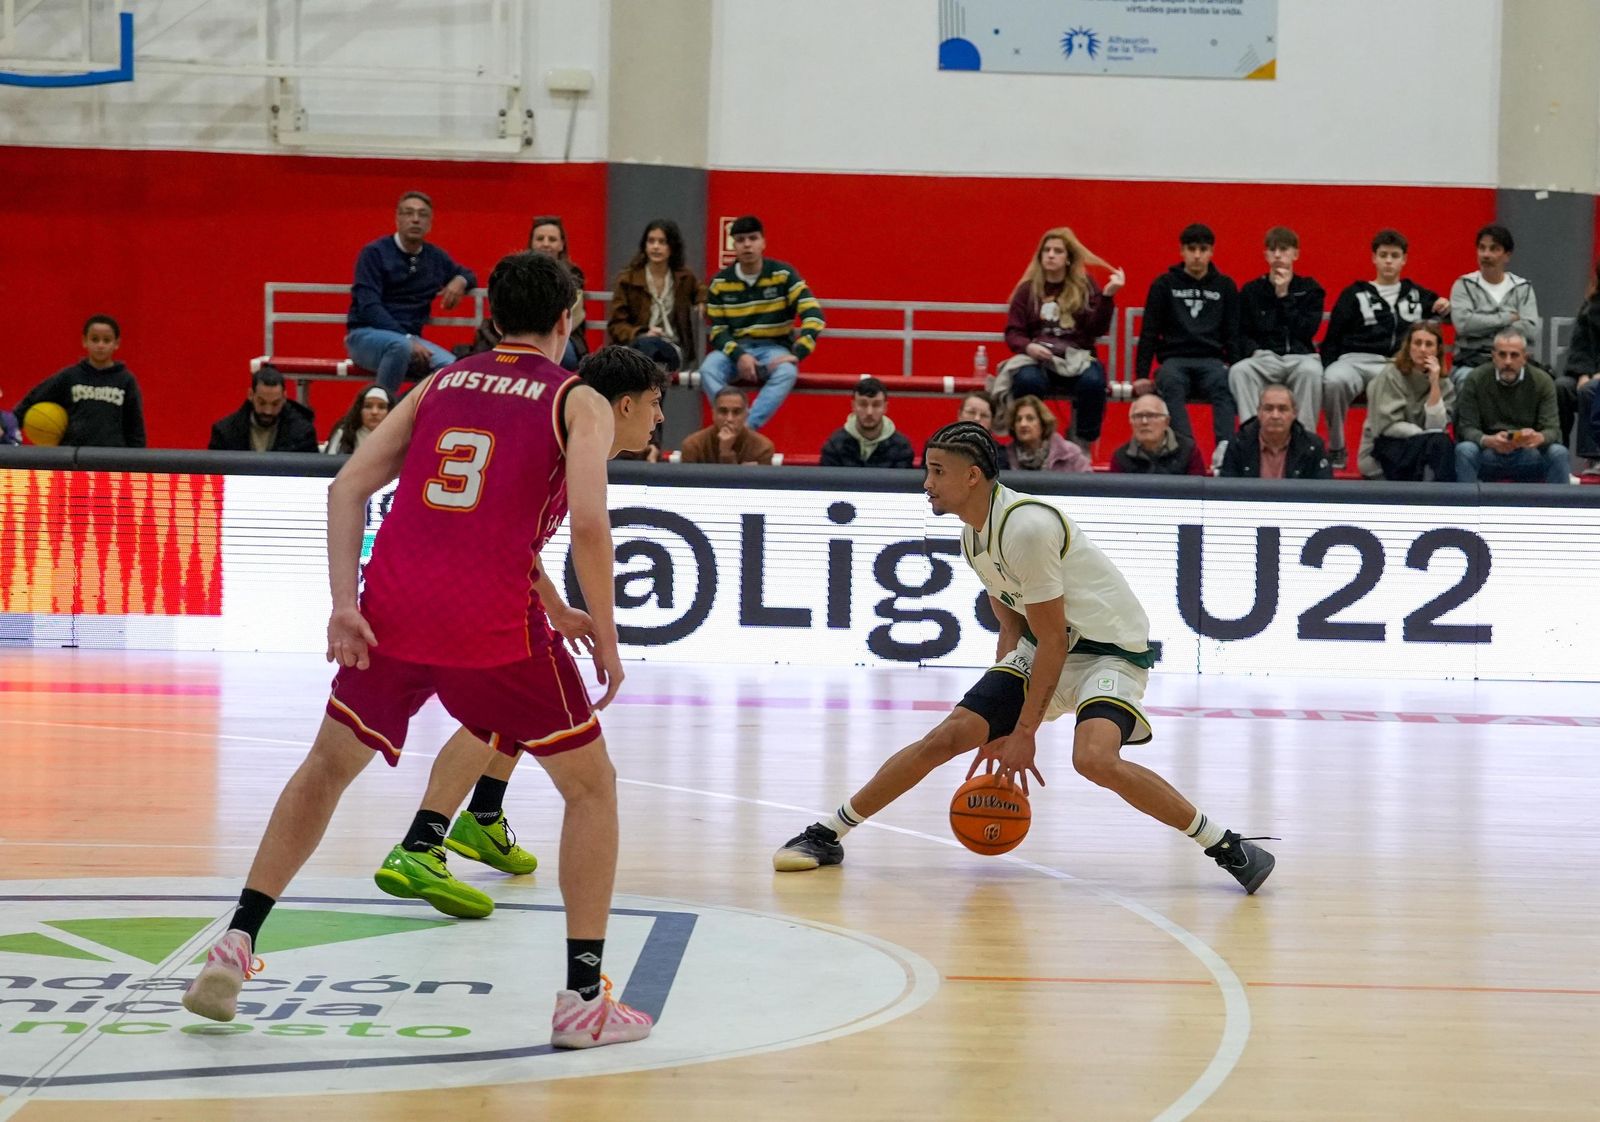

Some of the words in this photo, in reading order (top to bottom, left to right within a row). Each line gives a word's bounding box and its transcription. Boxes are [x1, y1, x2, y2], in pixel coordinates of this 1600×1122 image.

[1166, 7, 1187, 15] para
[1189, 6, 1209, 15] toda
[438, 371, 546, 400] GUSTRAN
[423, 427, 495, 512] 3
[967, 795, 1020, 812] Wilson
